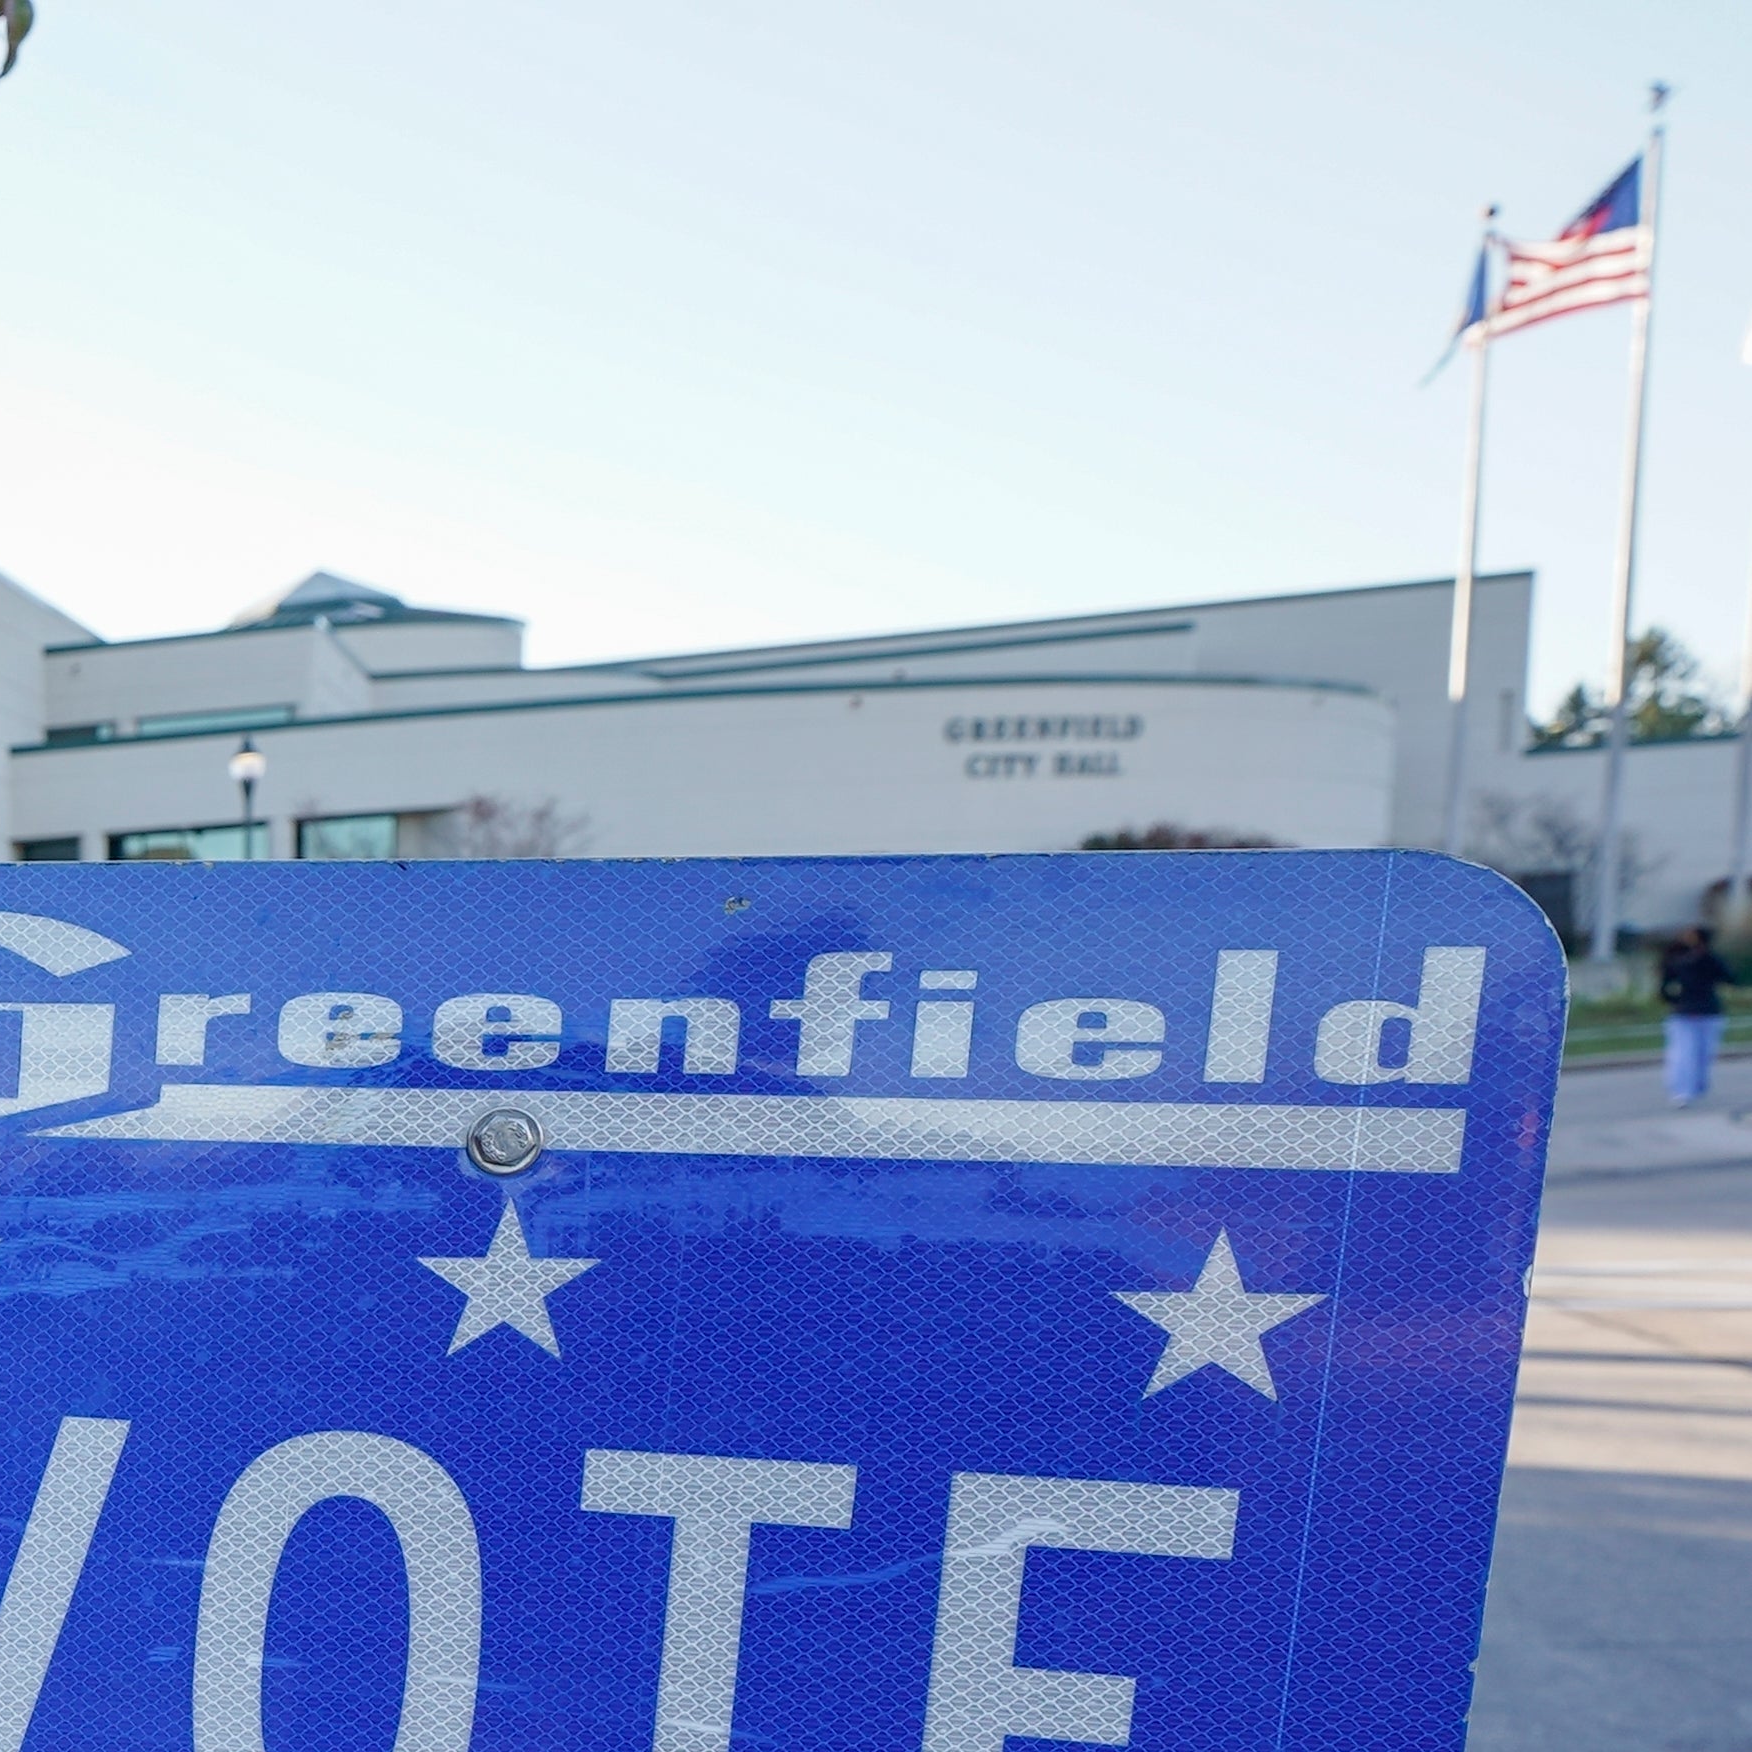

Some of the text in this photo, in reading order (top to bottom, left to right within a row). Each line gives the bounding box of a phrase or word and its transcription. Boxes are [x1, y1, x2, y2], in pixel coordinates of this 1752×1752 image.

[944, 714, 1144, 743] GREENFIELD
[964, 751, 1121, 779] CITY HALL
